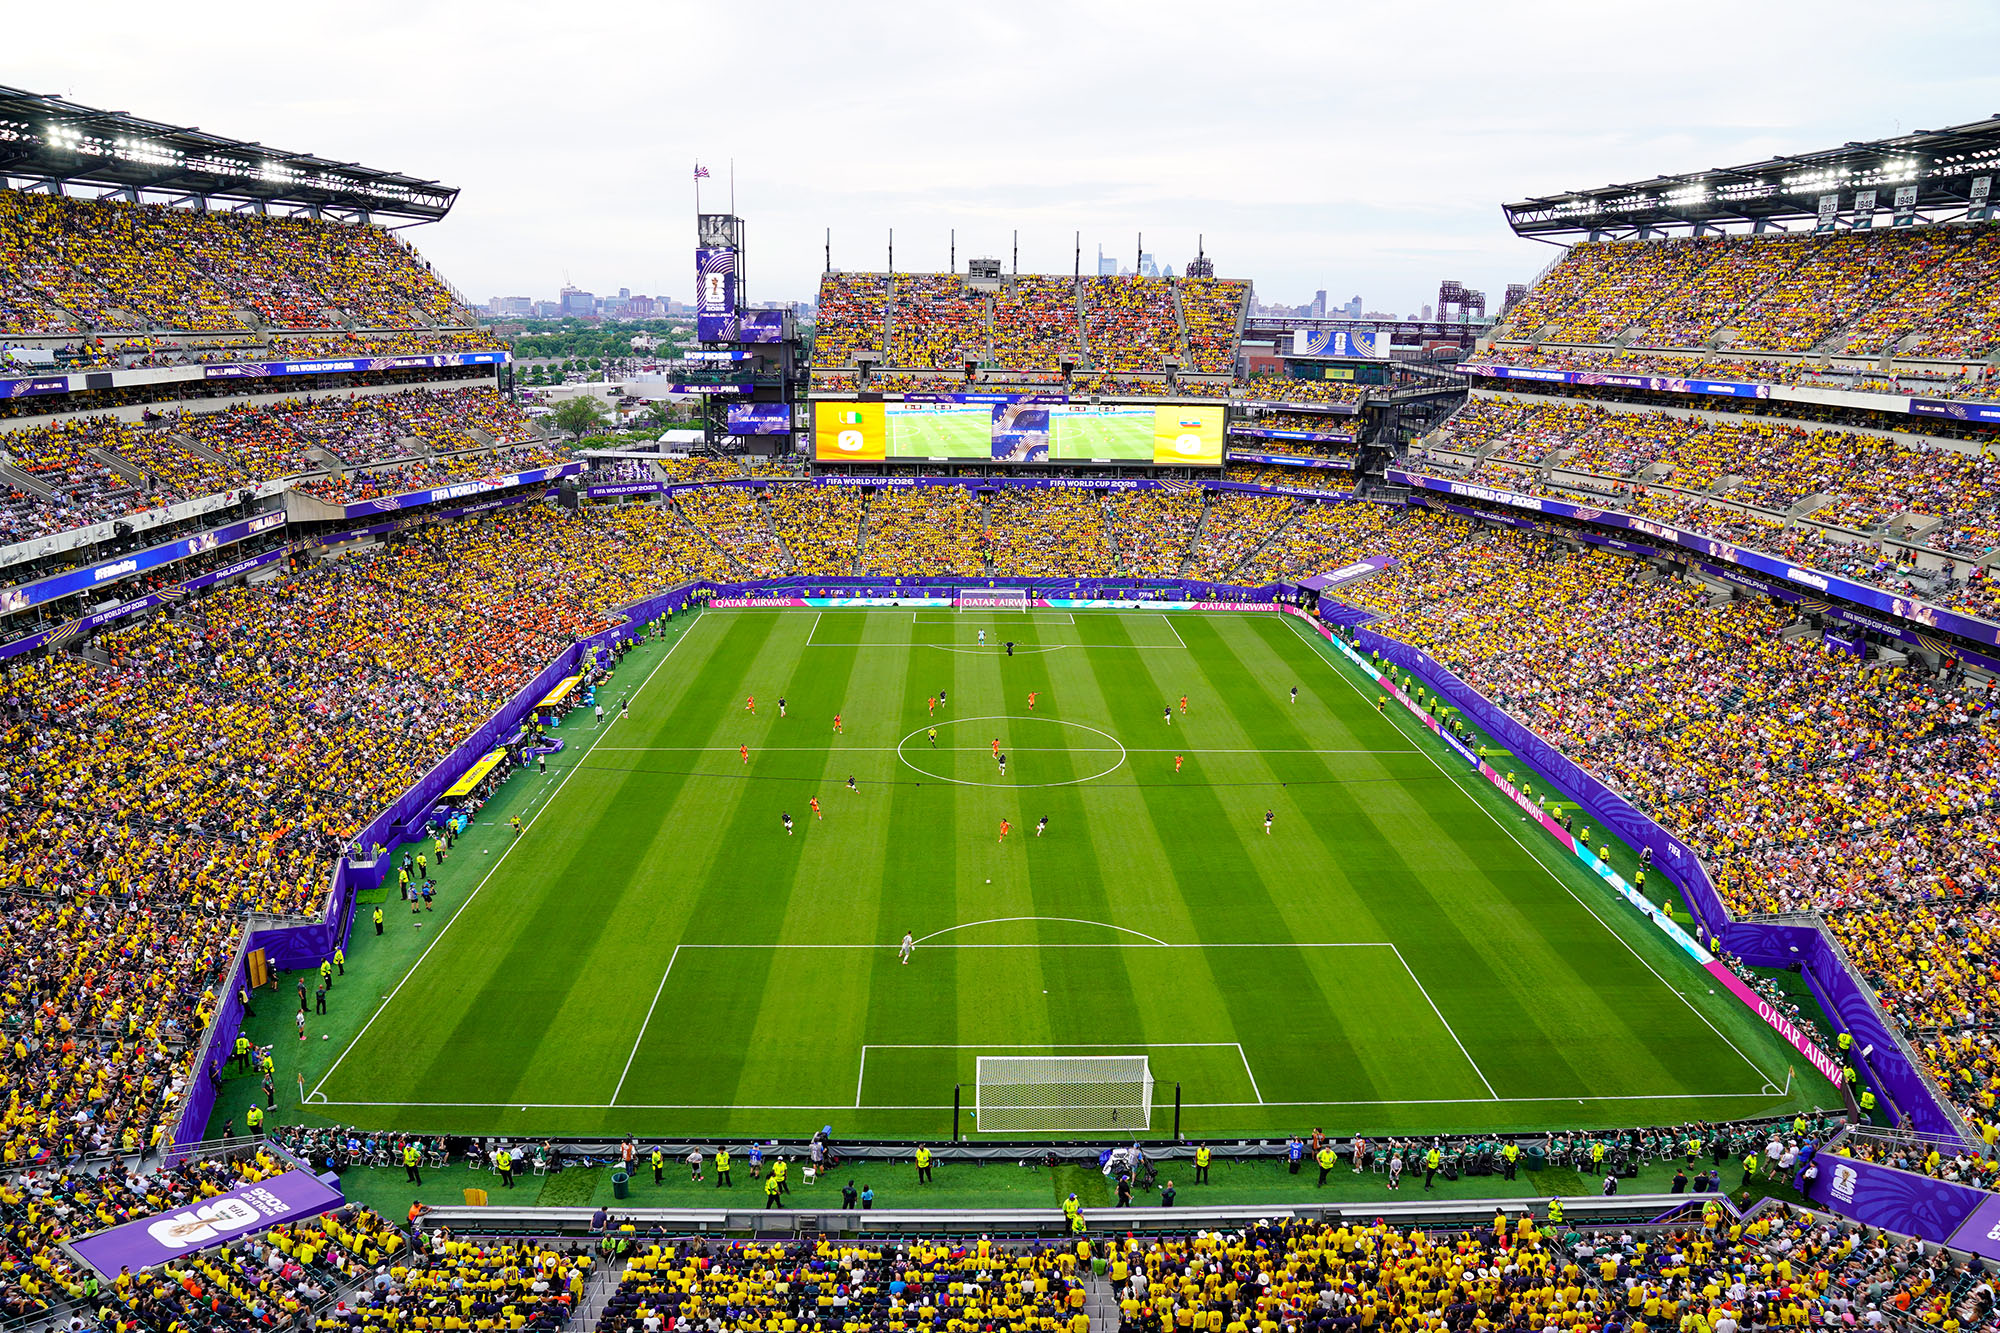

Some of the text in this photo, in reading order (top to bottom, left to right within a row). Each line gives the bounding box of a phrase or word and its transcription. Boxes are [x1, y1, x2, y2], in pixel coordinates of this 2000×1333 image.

[1820, 204, 1836, 213] 1947
[1857, 200, 1873, 209] 1948
[1897, 196, 1914, 205] 1949
[286, 364, 300, 373] FIFA
[300, 363, 322, 372] WORLD
[322, 362, 333, 371] CUP
[684, 385, 740, 393] PHILADELPHIA
[838, 430, 864, 451] 0
[1176, 434, 1201, 455] 0
[843, 478, 871, 486] WORLD
[1050, 479, 1138, 489] FIFA WORLD CUP 2026
[431, 489, 450, 501] FIFA
[449, 484, 478, 498] WORLD
[1276, 486, 1341, 498] PHILADELPHIA
[1450, 483, 1542, 511] FIFA WORLD CUP 2026
[462, 501, 503, 513] PHILADELPHIA
[248, 512, 286, 533] PHILADELP
[1473, 510, 1515, 524] PHILADELPHIA
[1628, 517, 1679, 542] PHILADELPHIA
[216, 559, 259, 580] PHILADELPHIA
[1723, 570, 1769, 592] PHILADELPHIA
[715, 598, 792, 608] QATAR AIRWAYS
[963, 598, 1039, 607] QATAR AIRWAYS
[1200, 602, 1274, 611] QATAR AIRWAYS
[92, 600, 148, 624] FIFA WORLD CUP 2026
[1842, 611, 1901, 636] FIFA WORLD CUP 2026
[1395, 688, 1428, 723] QATAR AIRWAYS
[1494, 774, 1543, 823] QATAR AIRWAYS
[1668, 842, 1680, 858] FIFA
[1758, 1000, 1801, 1049] QATAR
[240, 1192, 277, 1217] WORLD CUP
[250, 1187, 291, 1213] 2026
[1830, 1191, 1853, 1205] 2026
[228, 1204, 248, 1218] FIFA
